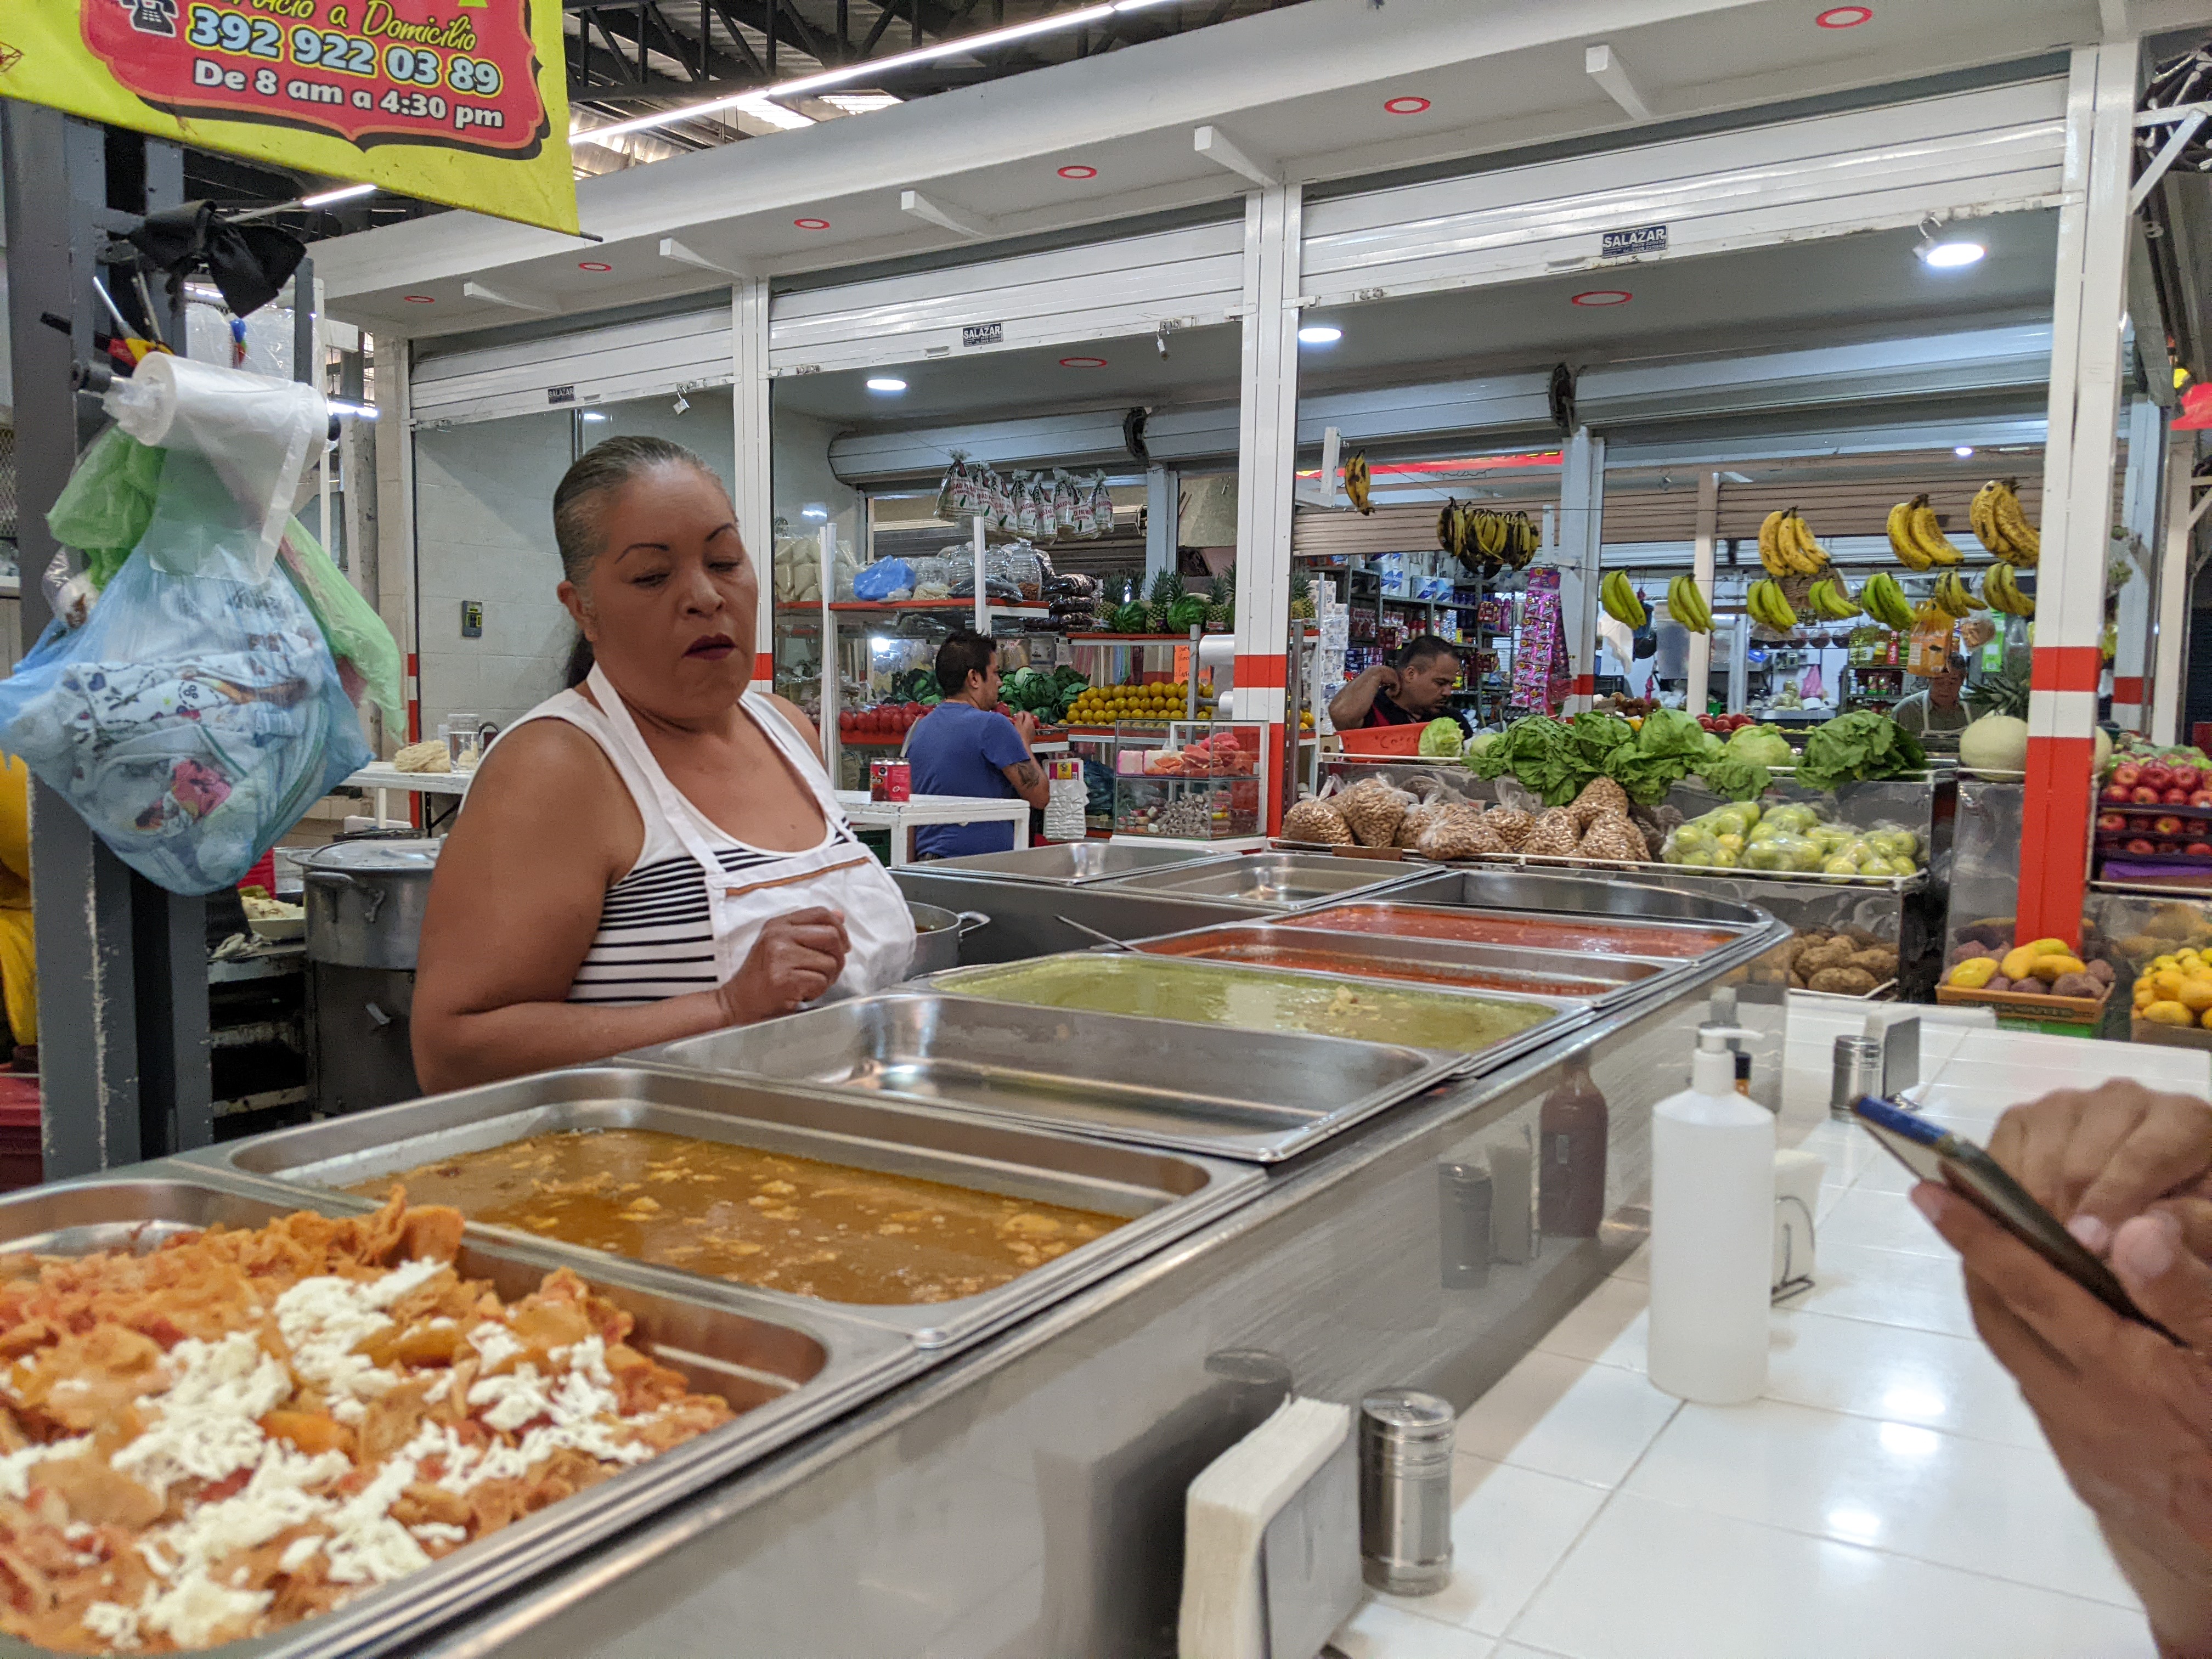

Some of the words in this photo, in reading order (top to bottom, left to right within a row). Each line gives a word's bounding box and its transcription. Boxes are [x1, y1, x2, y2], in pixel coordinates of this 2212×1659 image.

[187, 5, 283, 60] 392
[292, 25, 377, 76] 922
[384, 45, 440, 86] 03
[446, 54, 502, 96] 89
[329, 5, 348, 27] a
[361, 0, 477, 51] Domicilio
[194, 59, 246, 90] De
[255, 68, 278, 95] 8
[286, 78, 344, 105] am
[351, 89, 373, 109] a
[380, 91, 447, 120] 4:30
[454, 101, 504, 129] pm
[1602, 229, 1666, 248] SALAZAR
[963, 326, 1001, 340] SALAZAR
